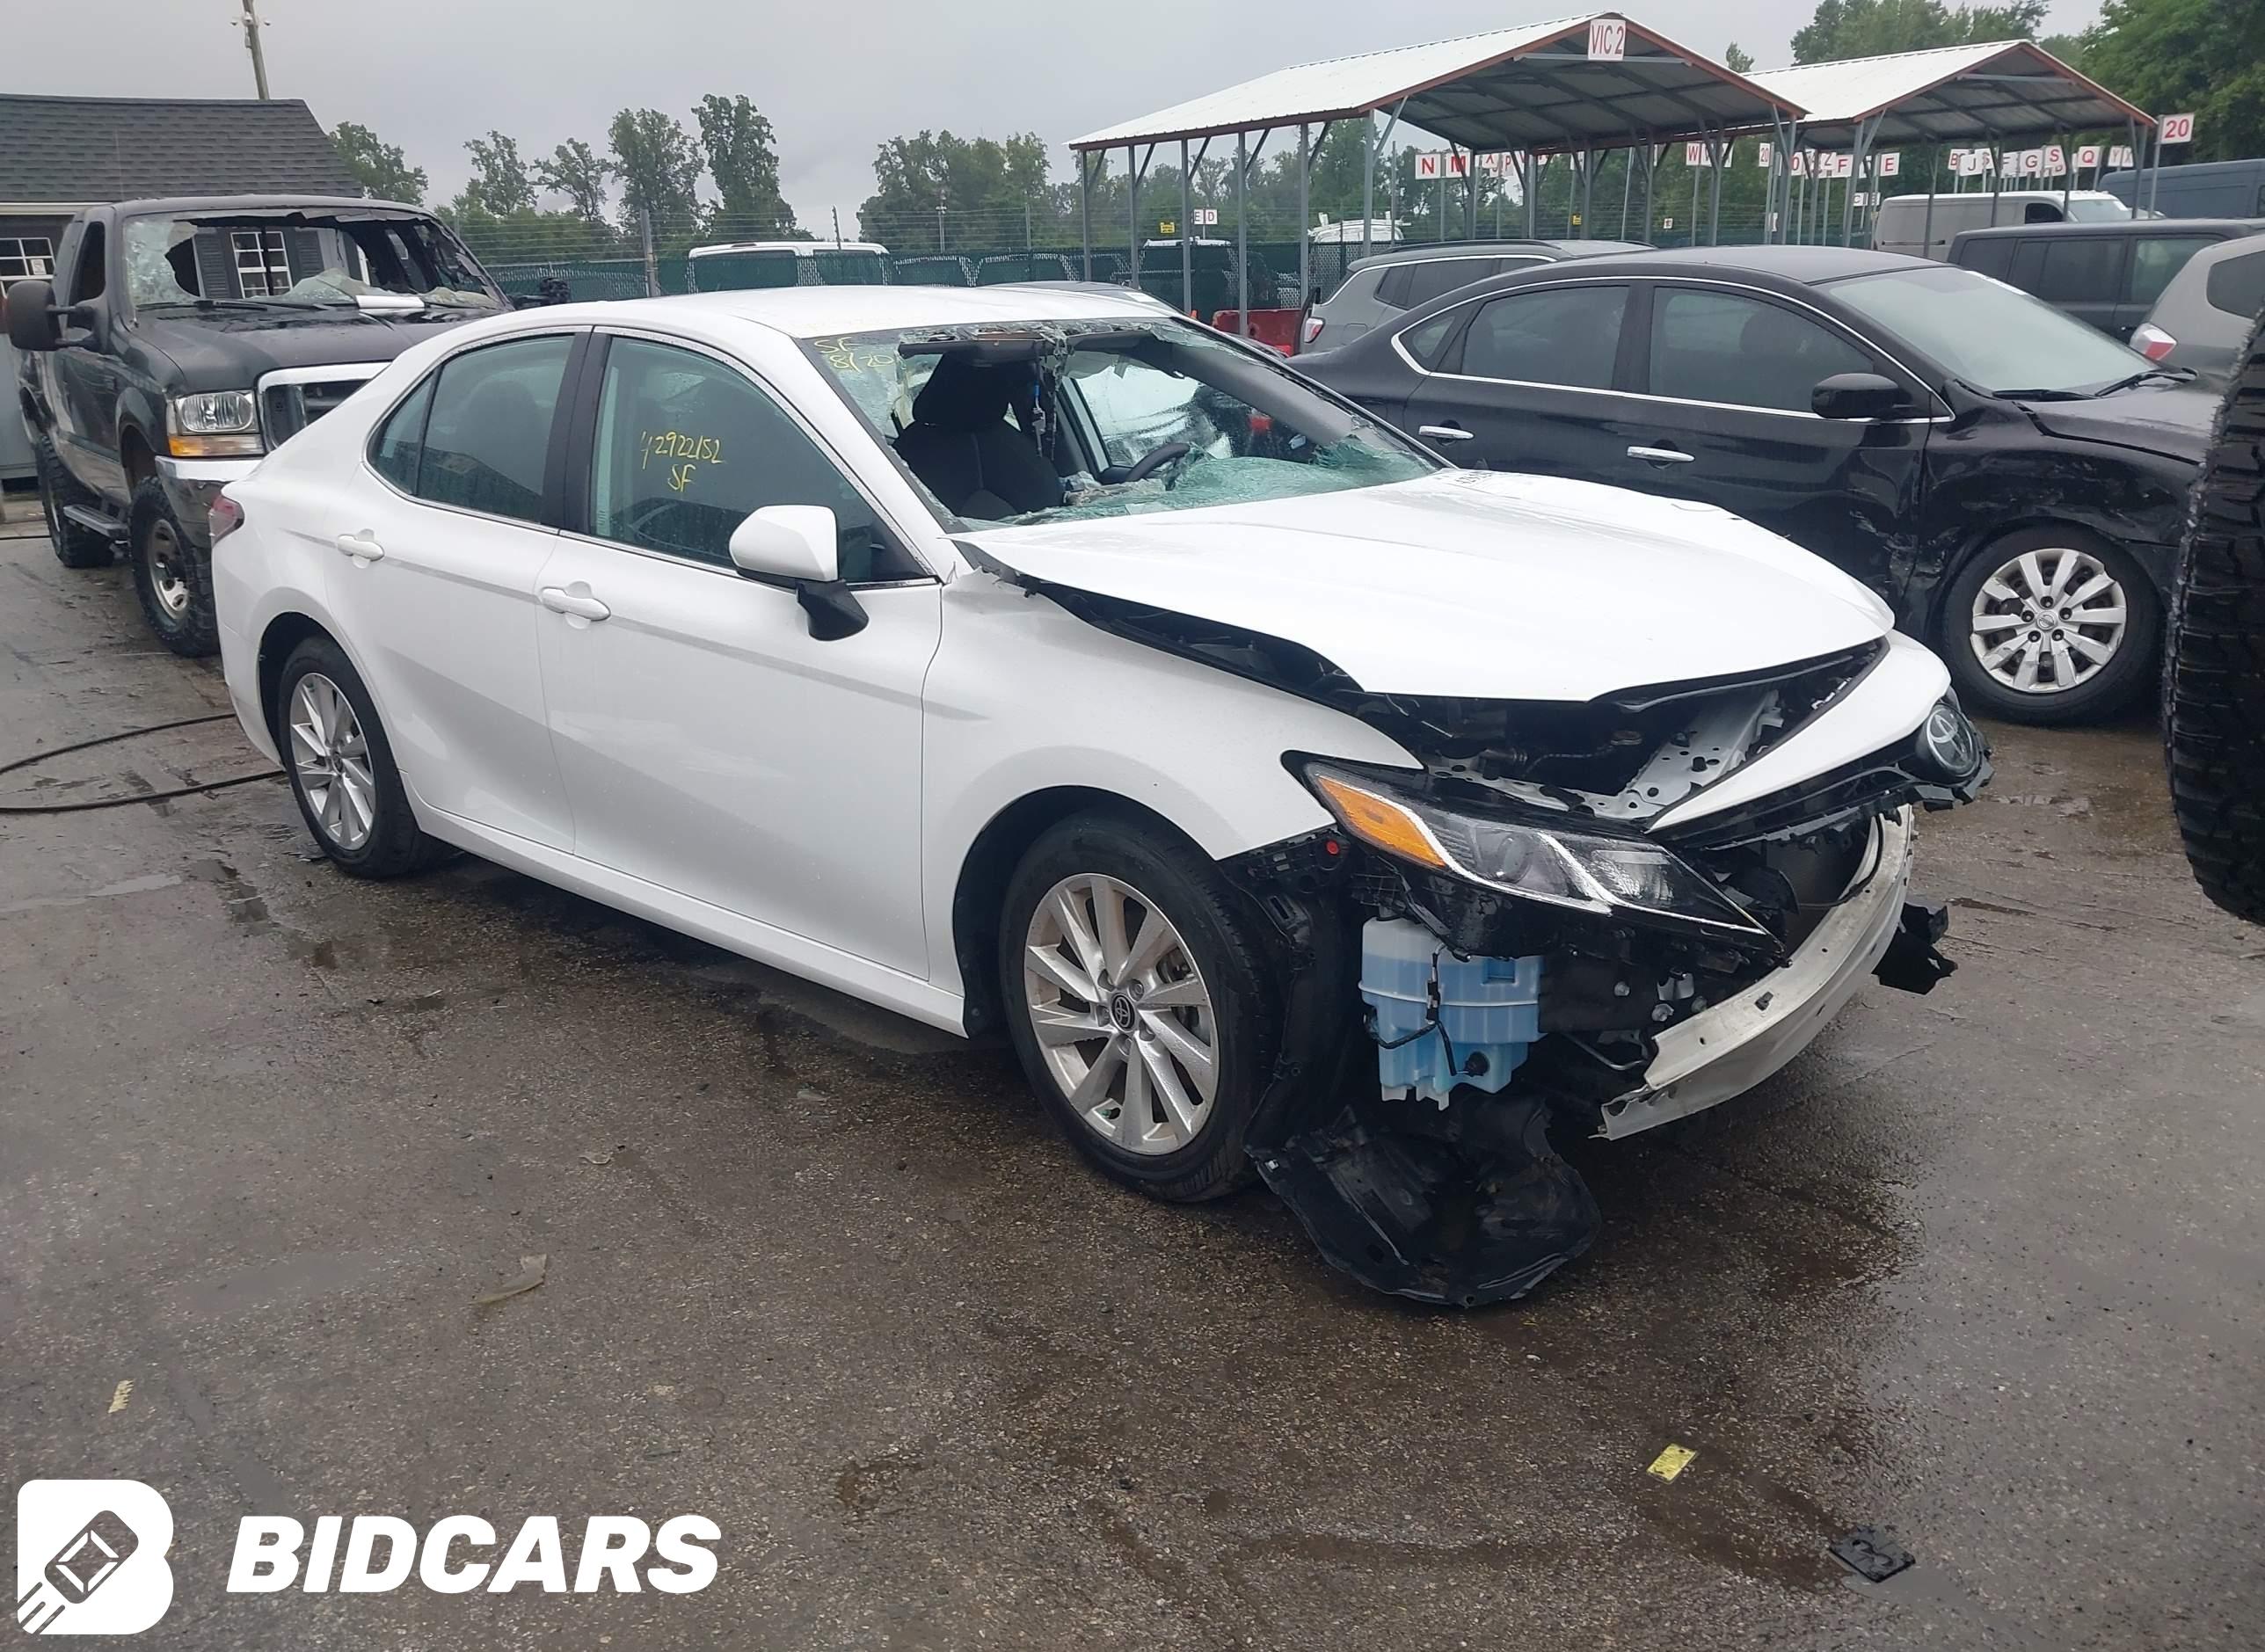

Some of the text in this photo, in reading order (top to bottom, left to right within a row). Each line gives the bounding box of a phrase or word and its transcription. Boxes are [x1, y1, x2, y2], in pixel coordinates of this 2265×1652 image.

[1591, 25, 1624, 55] VIC 2
[2165, 119, 2189, 139] 20
[1688, 145, 1699, 162] W
[2025, 155, 2037, 168] G
[2050, 149, 2059, 162] S
[2082, 150, 2094, 164] Q
[1422, 157, 1434, 175] N
[1451, 156, 1467, 172] M
[1838, 158, 1848, 173] F
[1884, 157, 1895, 172] E
[1968, 157, 1977, 171] J
[813, 336, 862, 354] SF
[667, 463, 696, 492] SF
